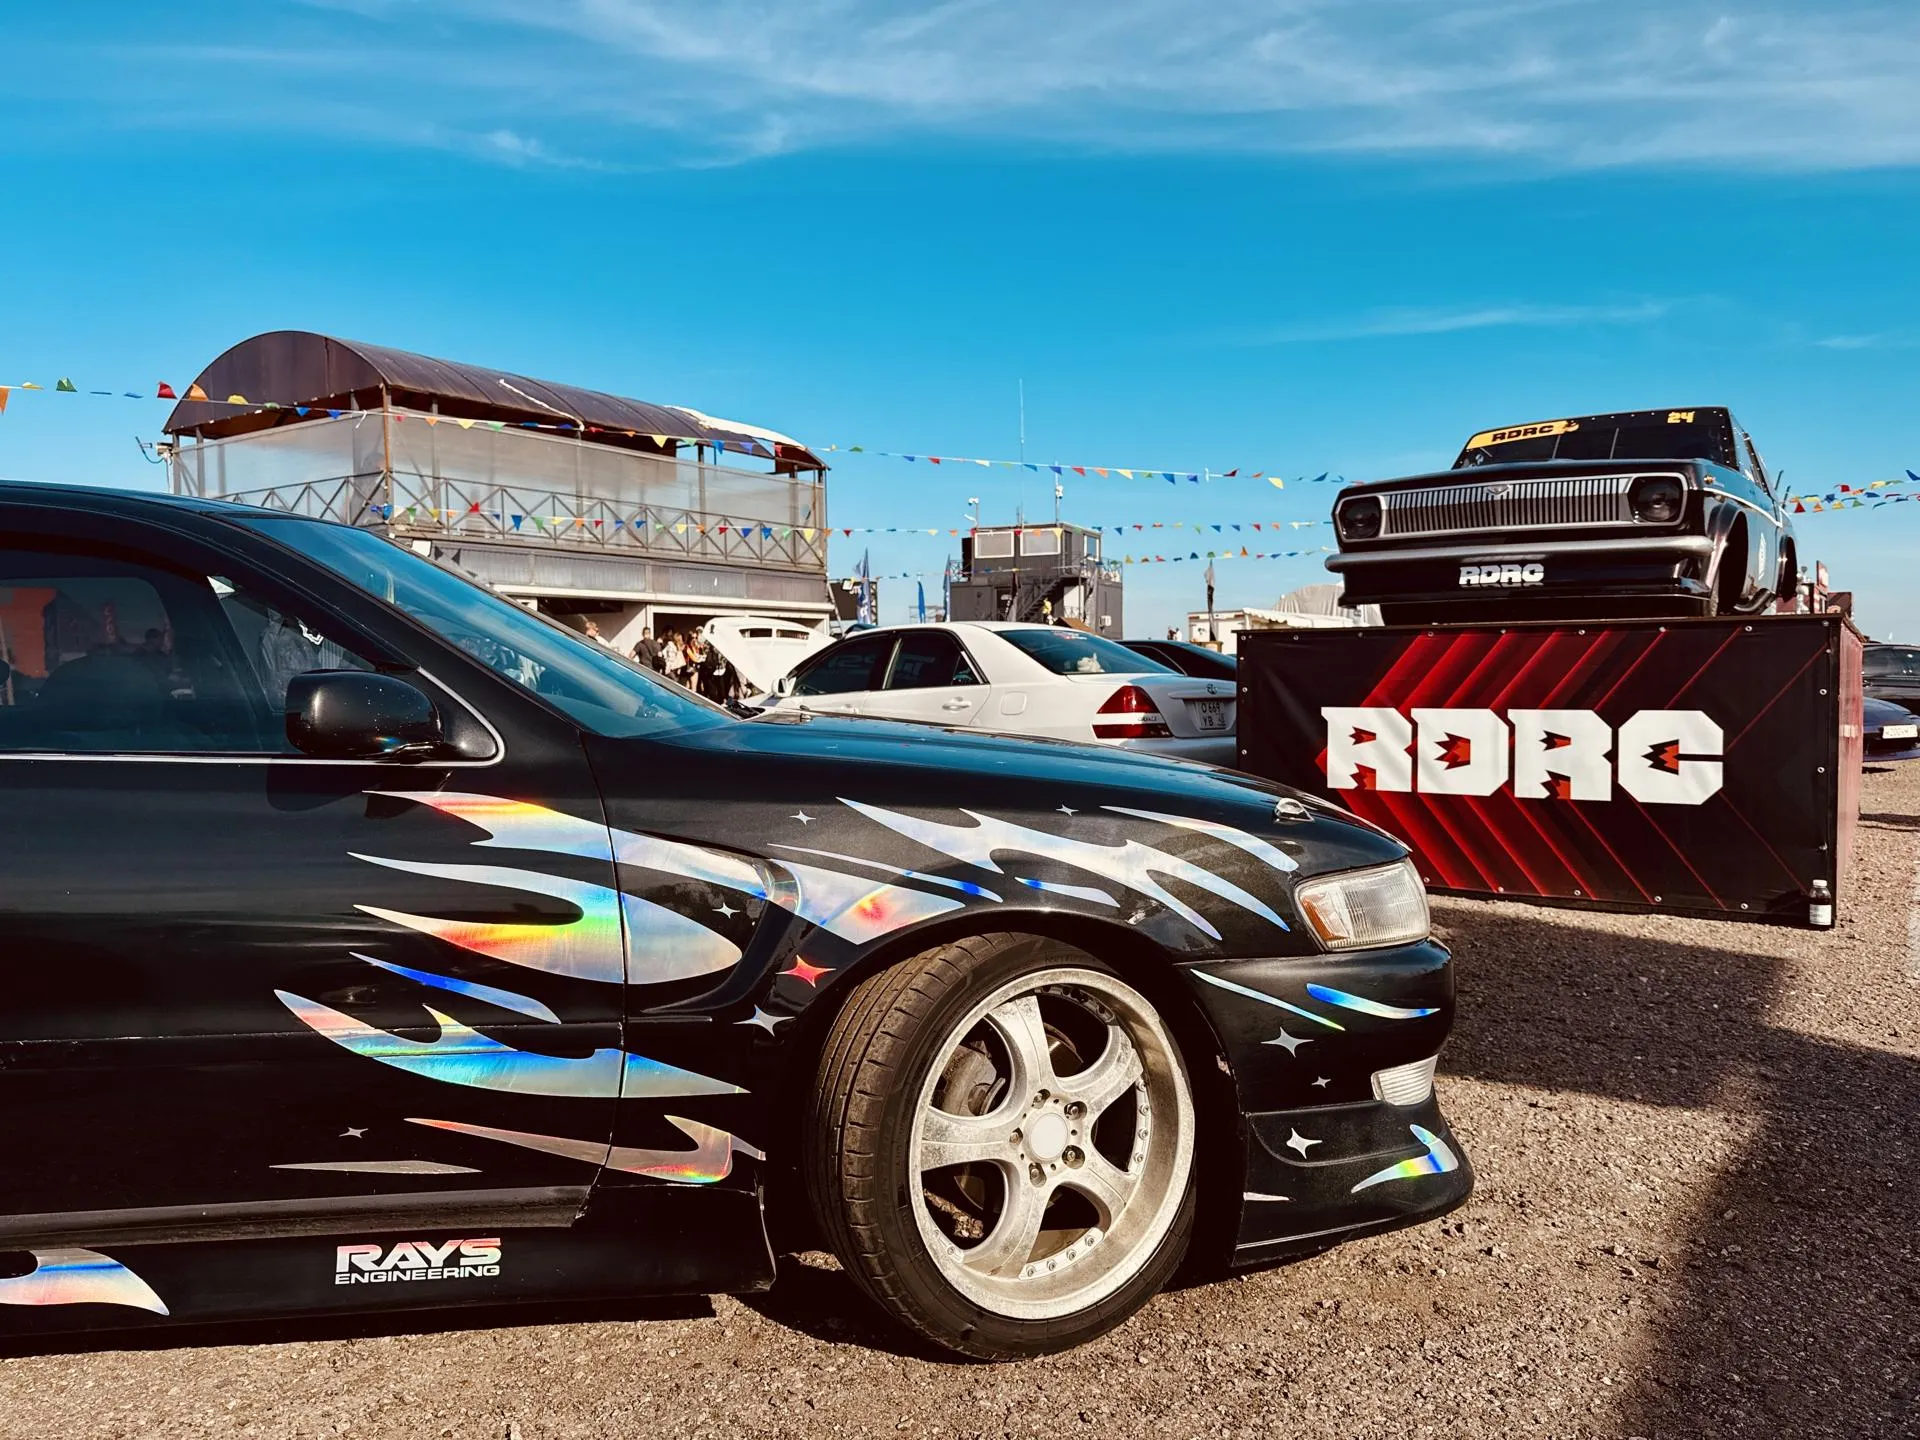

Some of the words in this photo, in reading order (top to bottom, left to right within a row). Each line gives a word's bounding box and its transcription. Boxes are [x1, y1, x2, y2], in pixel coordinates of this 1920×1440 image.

[1667, 411, 1695, 424] 24
[1491, 424, 1554, 442] RDRC
[1459, 563, 1544, 585] RDRC
[1321, 707, 1724, 805] RDRC
[336, 1237, 501, 1273] RAYS
[335, 1265, 500, 1285] ENGINEERING
